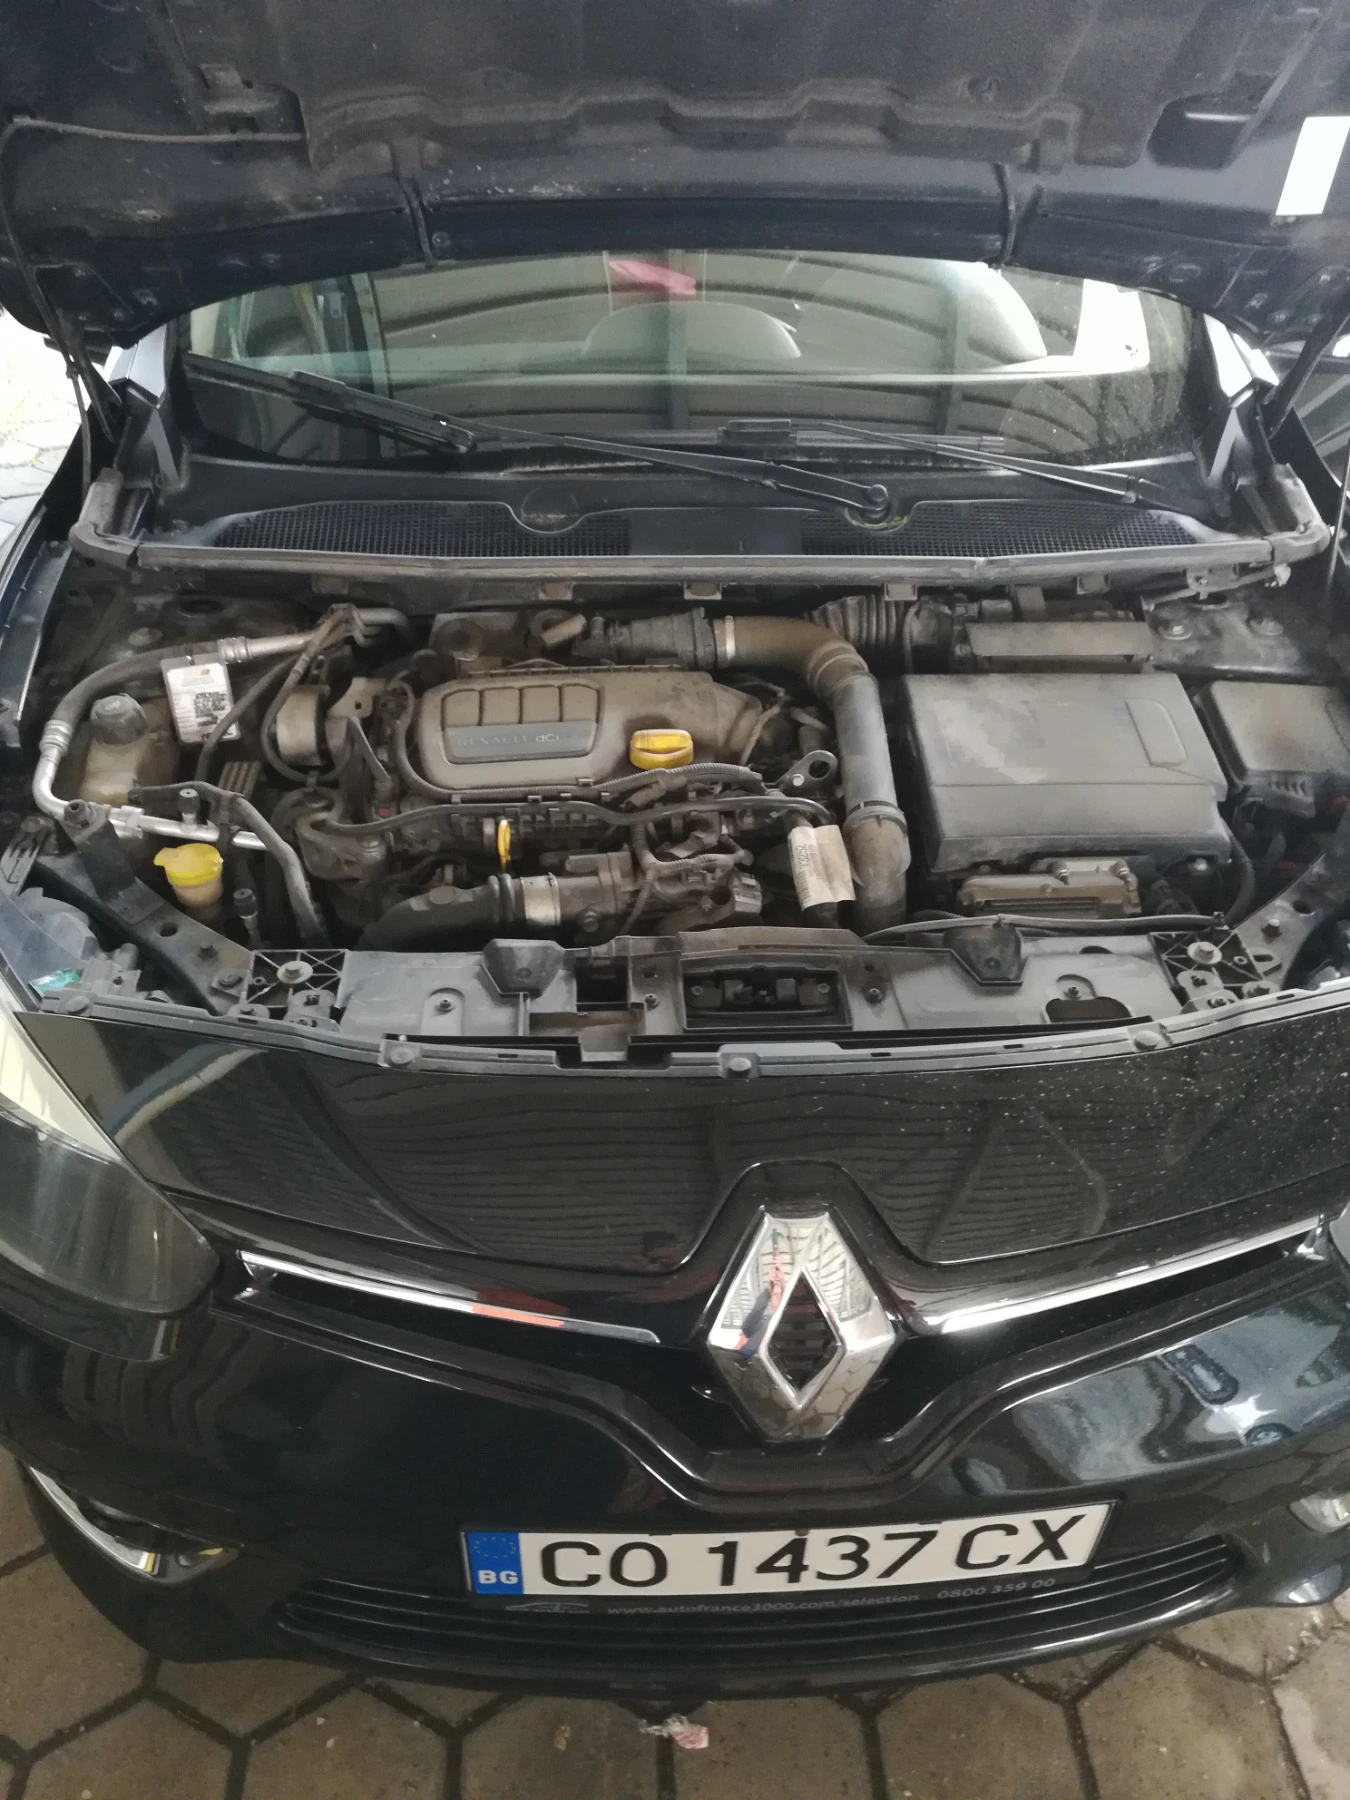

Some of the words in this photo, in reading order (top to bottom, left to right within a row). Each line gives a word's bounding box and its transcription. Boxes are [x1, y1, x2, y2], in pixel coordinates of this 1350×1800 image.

[540, 1540, 668, 1588] CO
[707, 1530, 938, 1587] 1437
[954, 1513, 1087, 1570] CX
[477, 1569, 519, 1585] BG
[937, 1586, 986, 1600] 0800
[989, 1581, 1028, 1595] 359
[1031, 1578, 1056, 1590] 00
